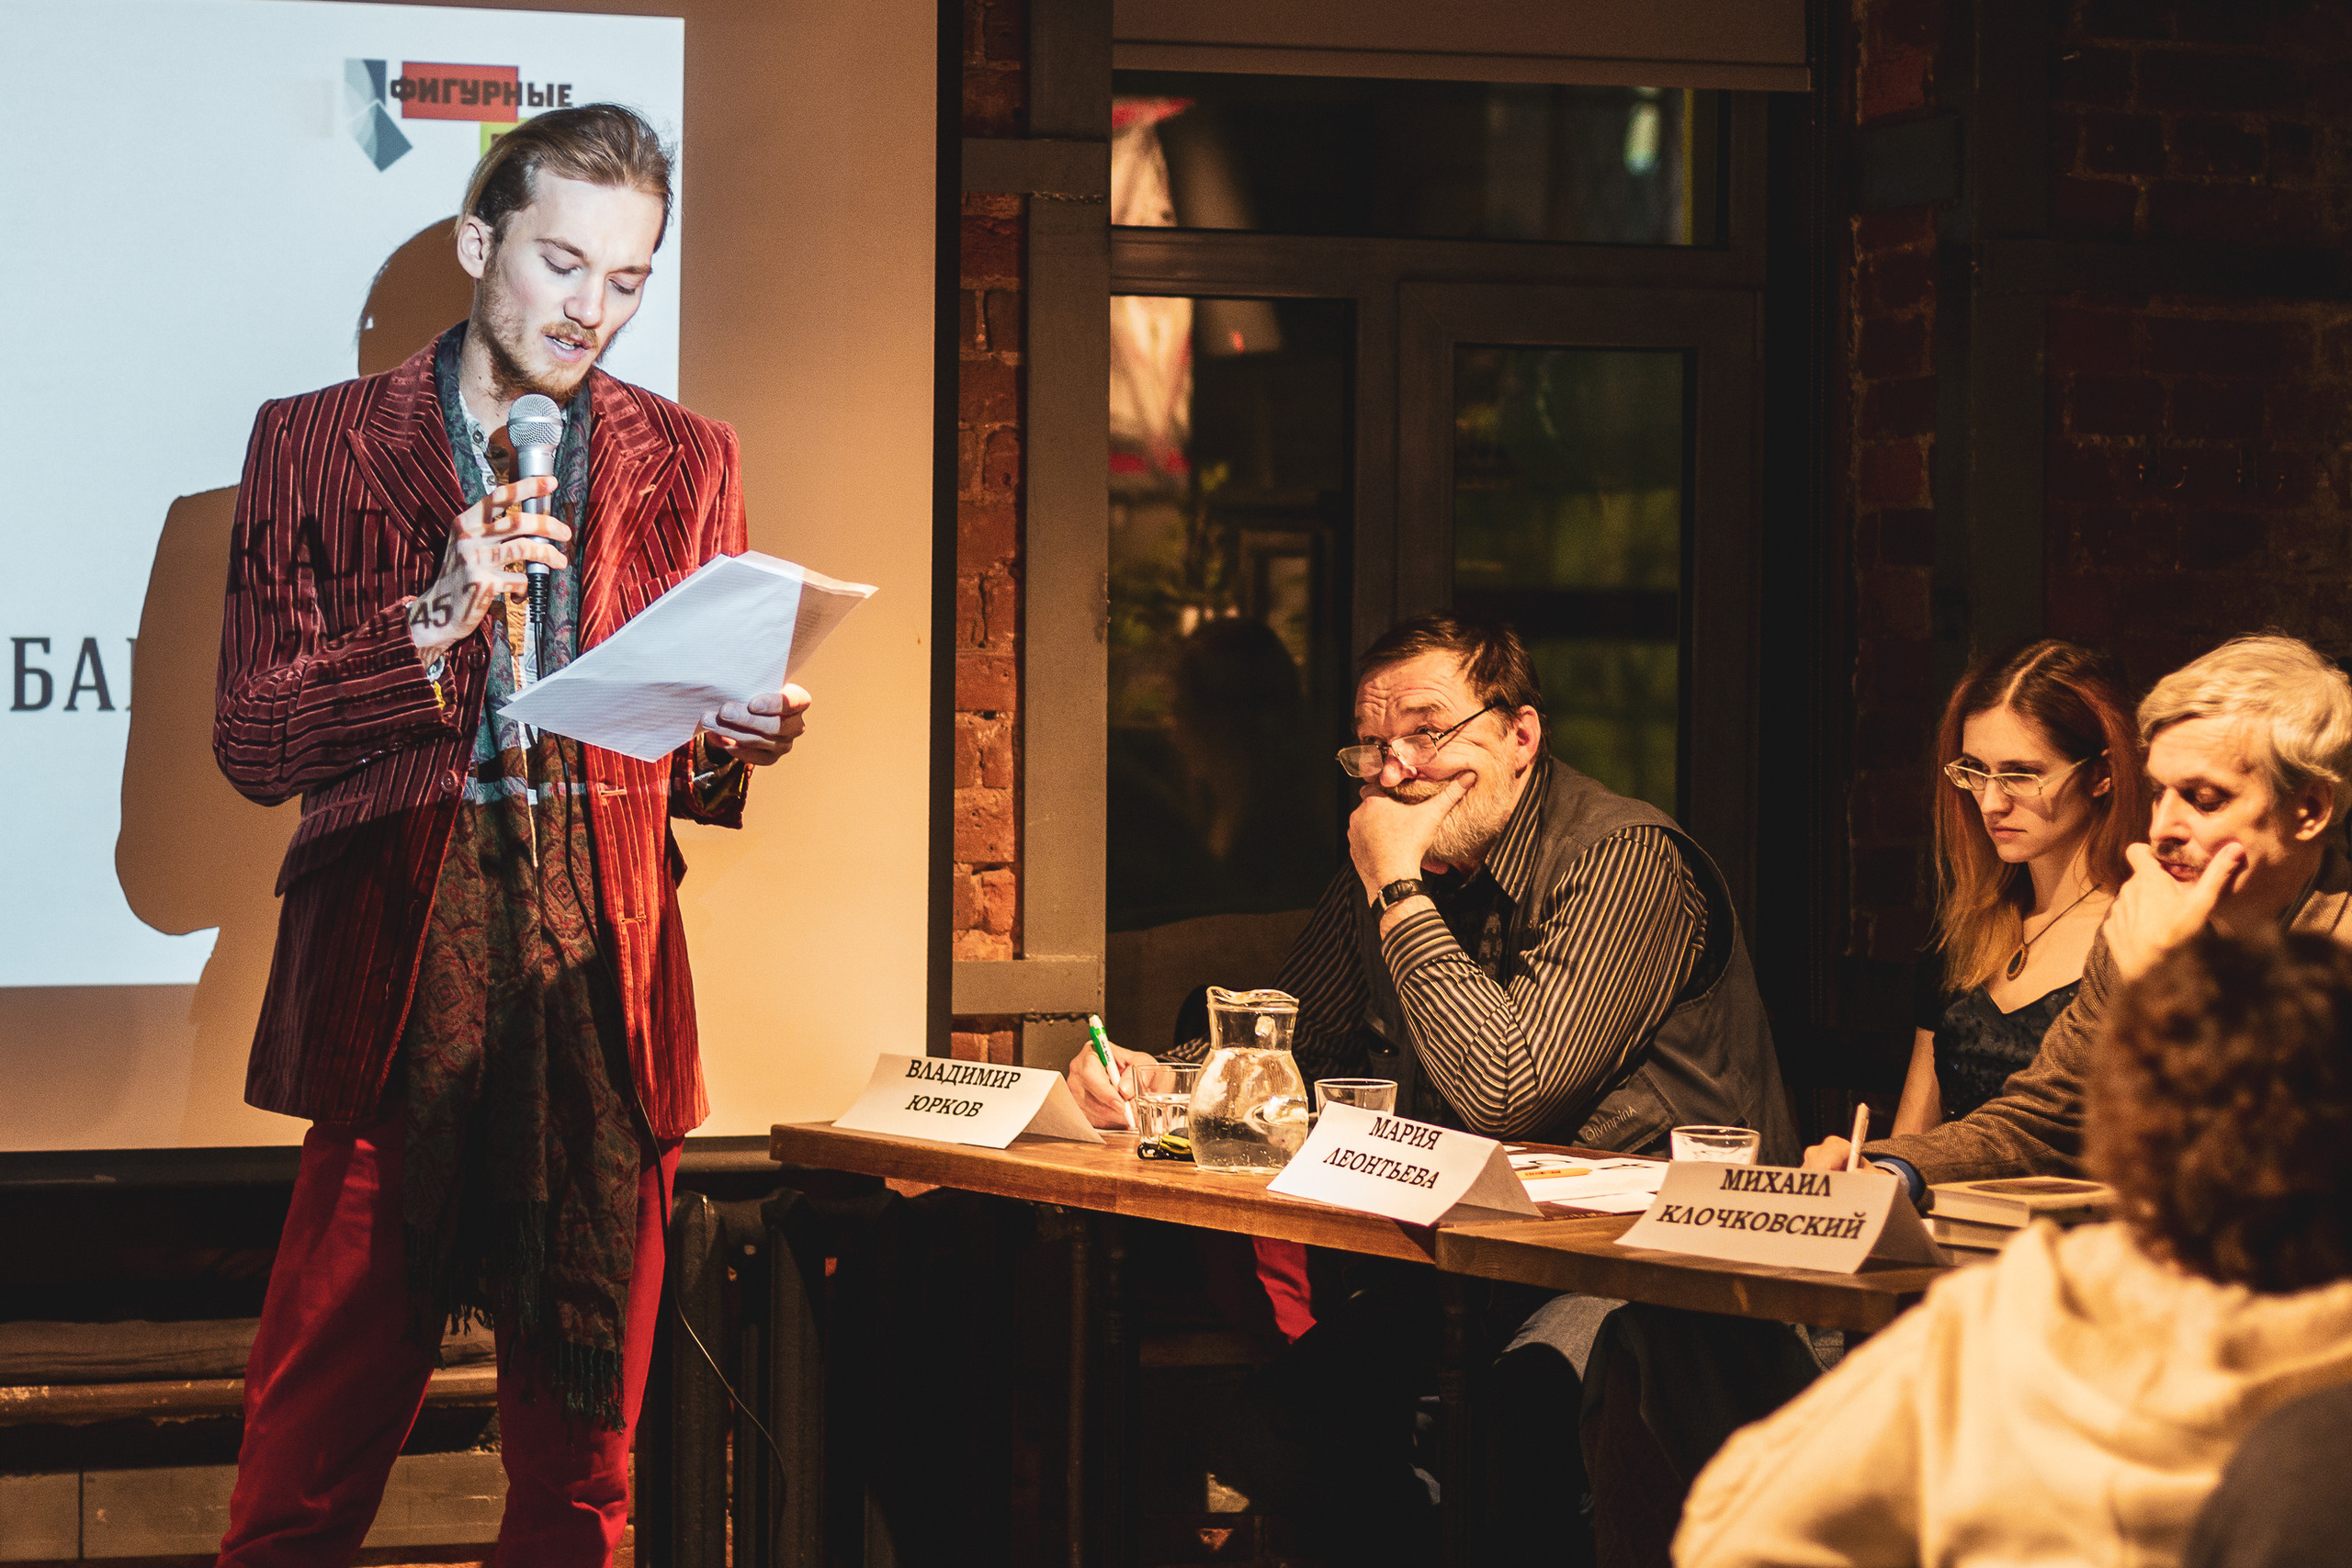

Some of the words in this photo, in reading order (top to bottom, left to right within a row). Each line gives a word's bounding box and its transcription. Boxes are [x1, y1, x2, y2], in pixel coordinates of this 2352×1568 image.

[390, 77, 574, 108] ФИГУРНЫЕ
[10, 637, 138, 712] БА
[905, 1059, 1022, 1089] ВЛАДИМИР
[905, 1094, 984, 1117] ЮРКОВ
[1368, 1116, 1443, 1151] МАРИЯ
[1323, 1147, 1441, 1190] ЛЕОНТЬЕВА
[1719, 1168, 1831, 1198] МИХАИЛ
[1656, 1204, 1868, 1240] КЛОЧКОВСКИЙ
